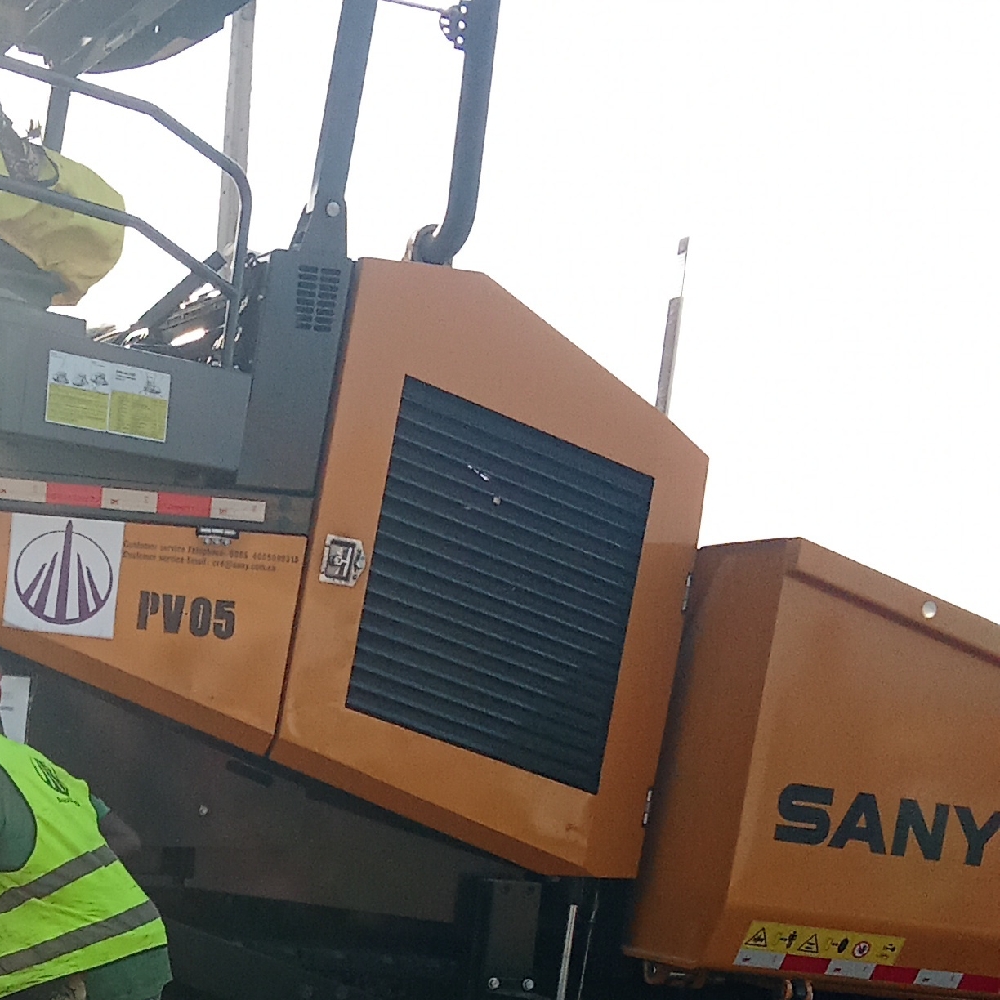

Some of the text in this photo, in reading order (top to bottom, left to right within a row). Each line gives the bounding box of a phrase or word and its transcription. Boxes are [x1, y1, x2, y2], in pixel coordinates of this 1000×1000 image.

[123, 540, 158, 550] Customer
[160, 544, 186, 552] service
[122, 550, 157, 560] Customer
[159, 555, 185, 564] service
[773, 782, 1000, 868] SANY
